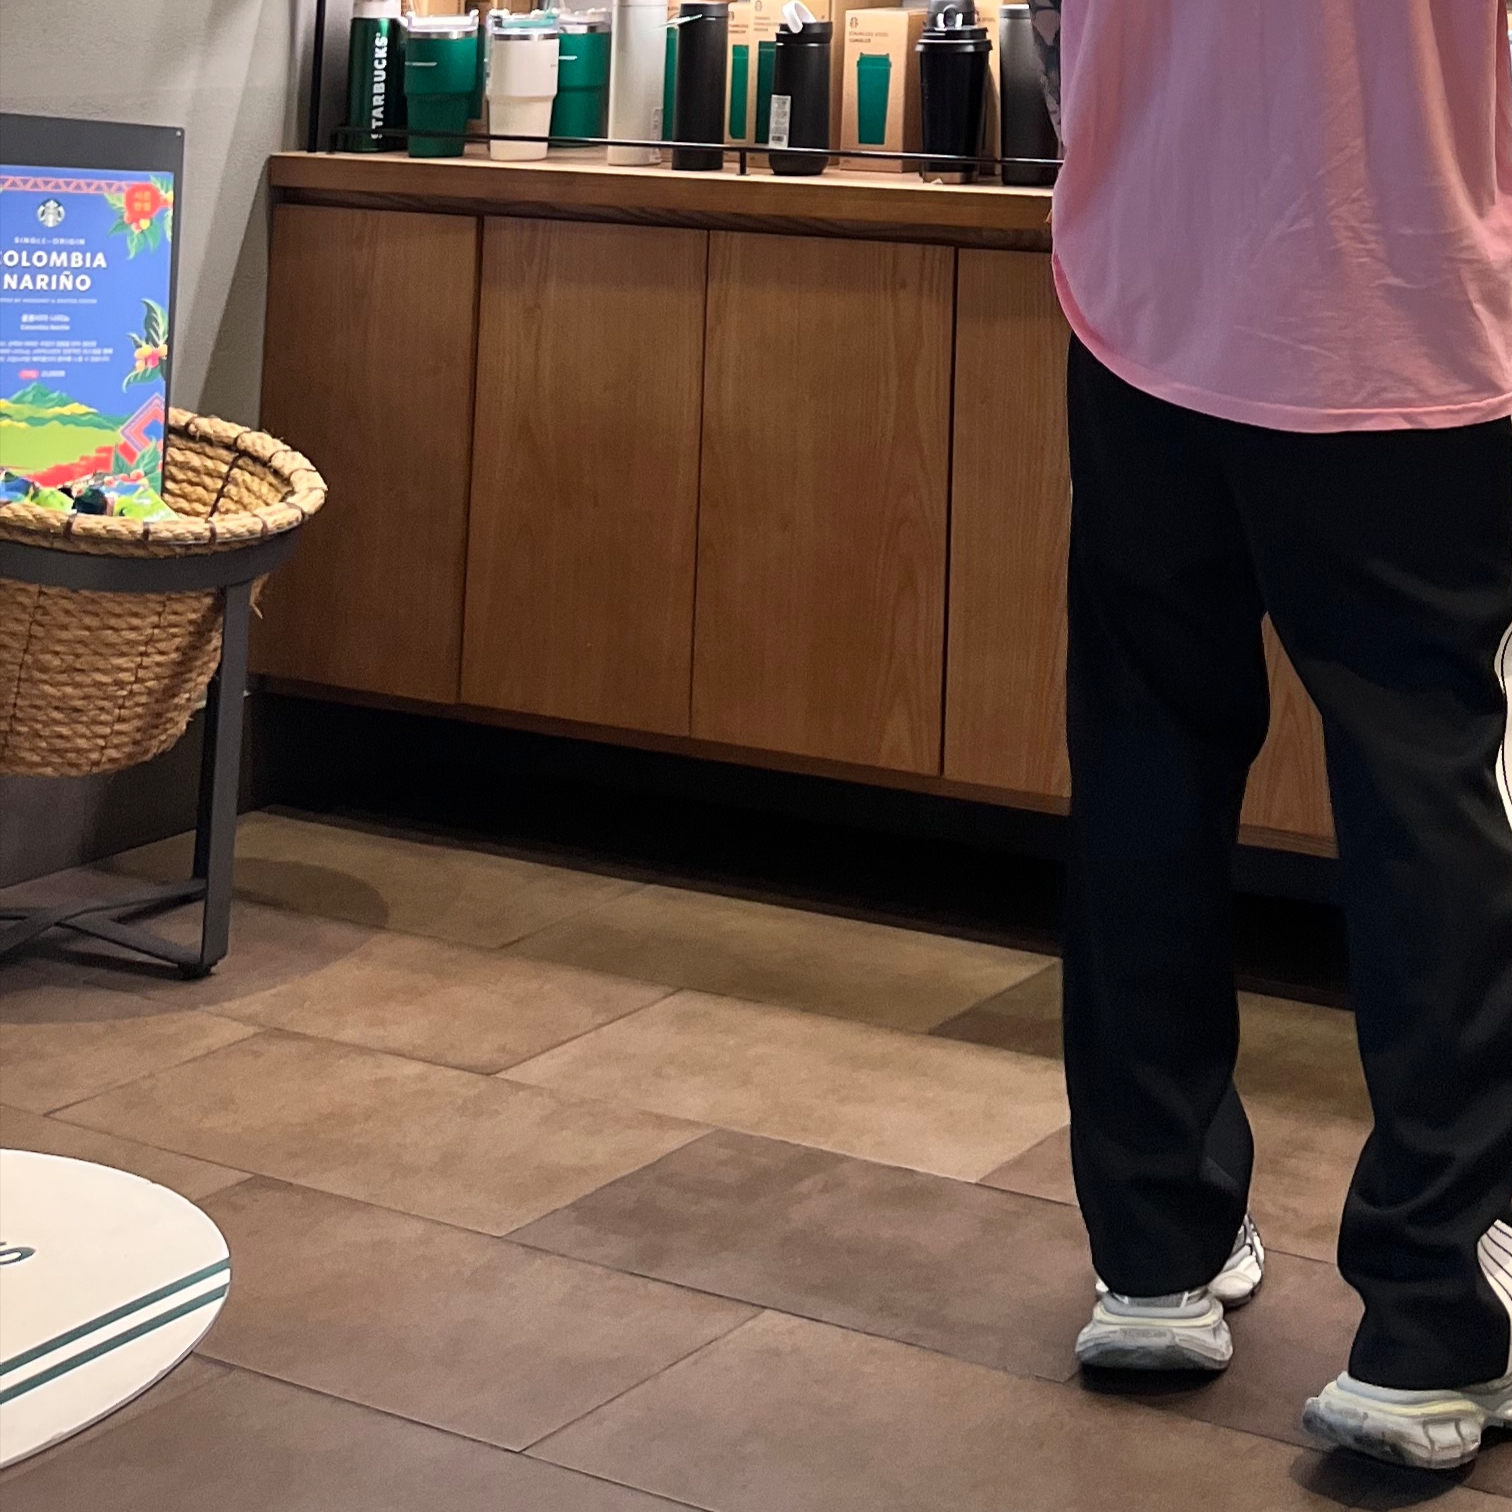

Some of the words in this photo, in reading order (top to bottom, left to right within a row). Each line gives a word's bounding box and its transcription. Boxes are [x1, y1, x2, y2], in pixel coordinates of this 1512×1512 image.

[14, 237, 85, 245] SINGLE-ORIGIN
[0, 250, 107, 268] OLOMBIA
[4, 271, 91, 291] NARIÑO
